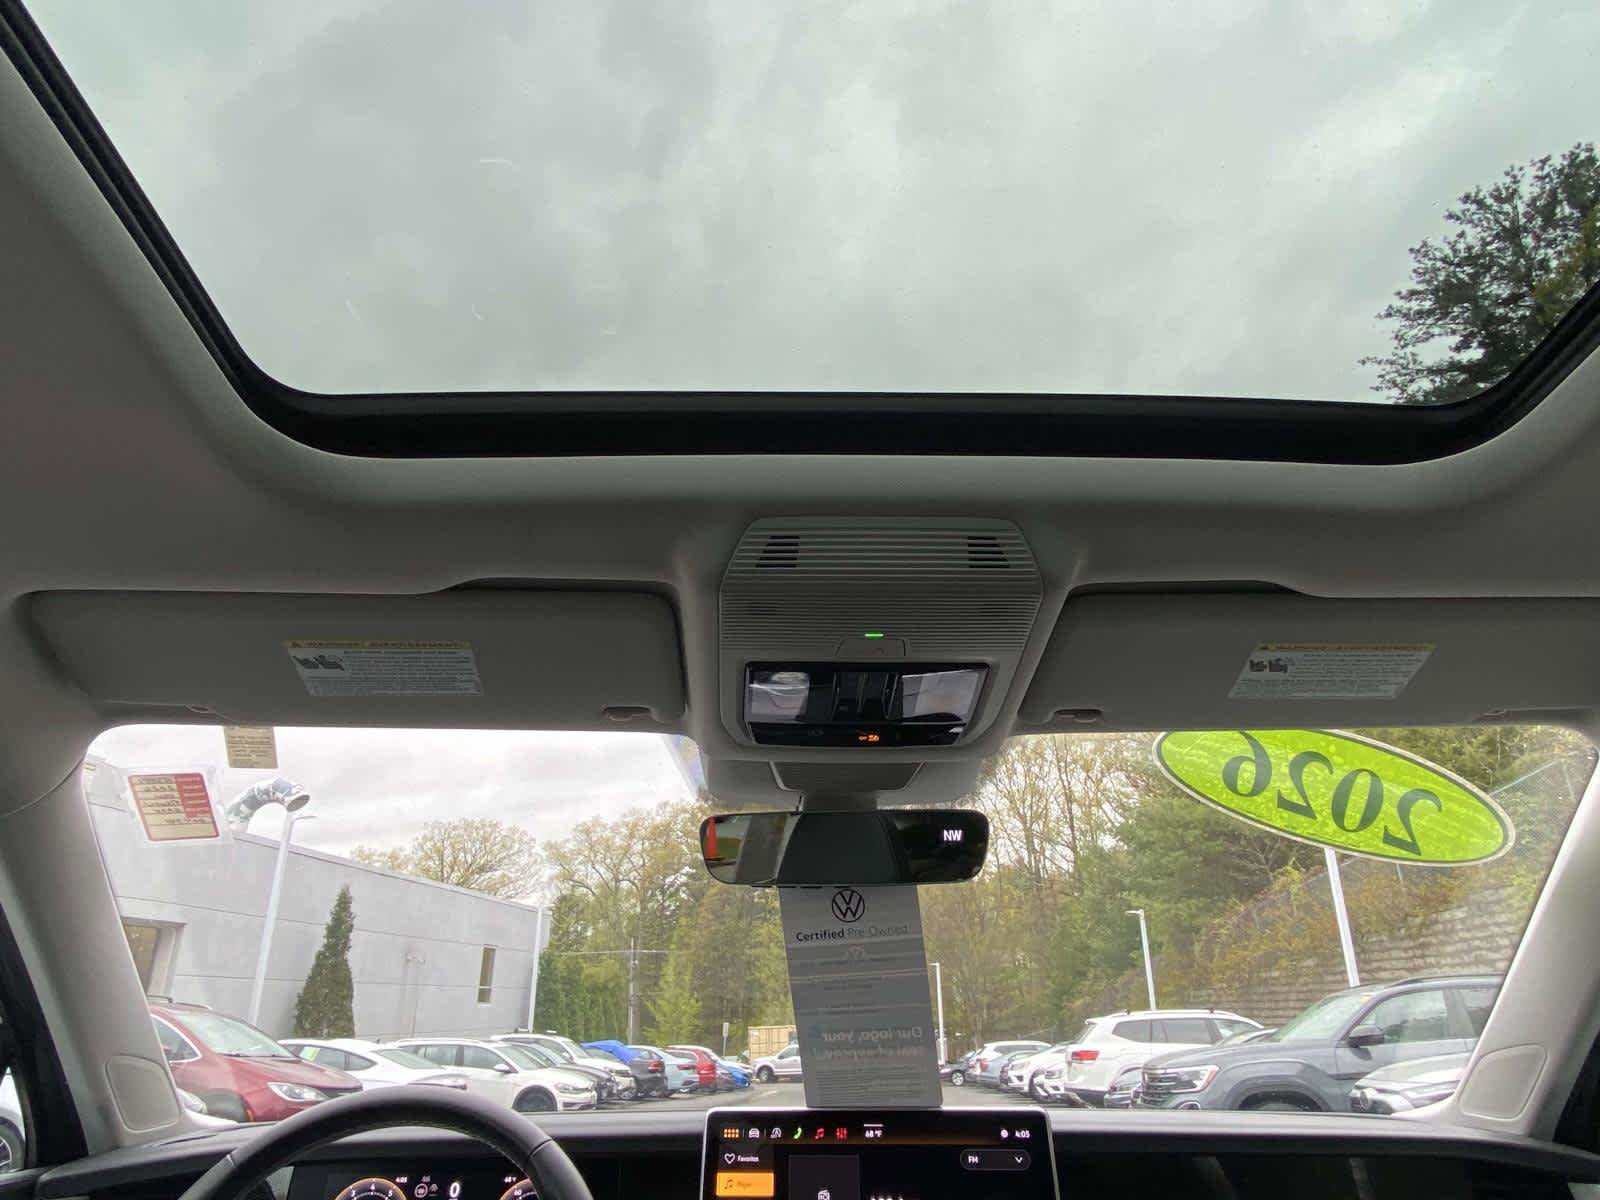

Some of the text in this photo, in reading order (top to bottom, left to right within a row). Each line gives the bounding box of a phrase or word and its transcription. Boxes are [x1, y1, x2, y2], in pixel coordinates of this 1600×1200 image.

[943, 829, 962, 842] NW
[796, 928, 845, 942] Certified
[1014, 1129, 1030, 1139] 4:05
[449, 1182, 461, 1198] 0
